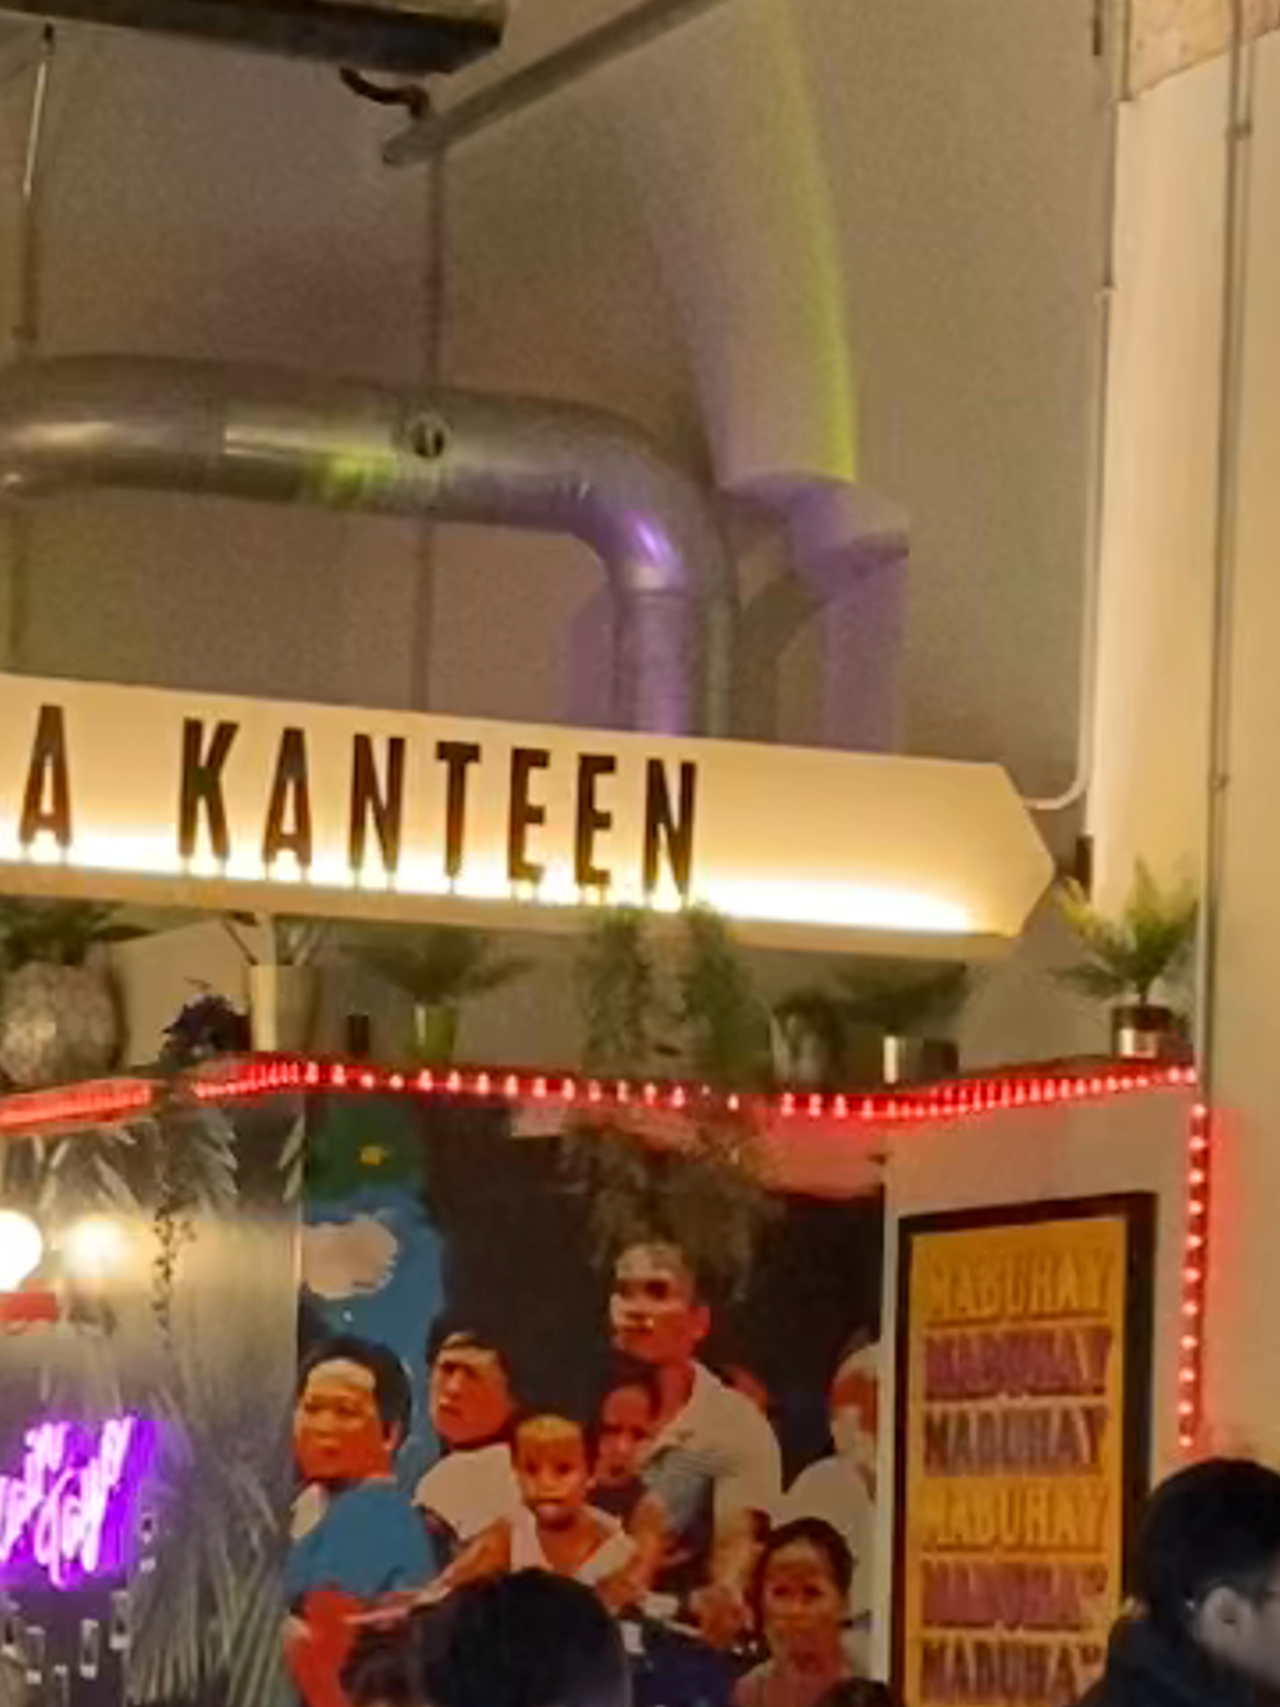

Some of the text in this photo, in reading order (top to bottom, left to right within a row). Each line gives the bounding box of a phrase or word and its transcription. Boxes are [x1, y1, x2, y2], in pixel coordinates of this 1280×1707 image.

[178, 717, 698, 896] KANTEEN
[925, 1249, 1111, 1321] MABUHAY
[923, 1403, 1108, 1477] MABUHAY
[922, 1479, 1108, 1549] MABUHAY
